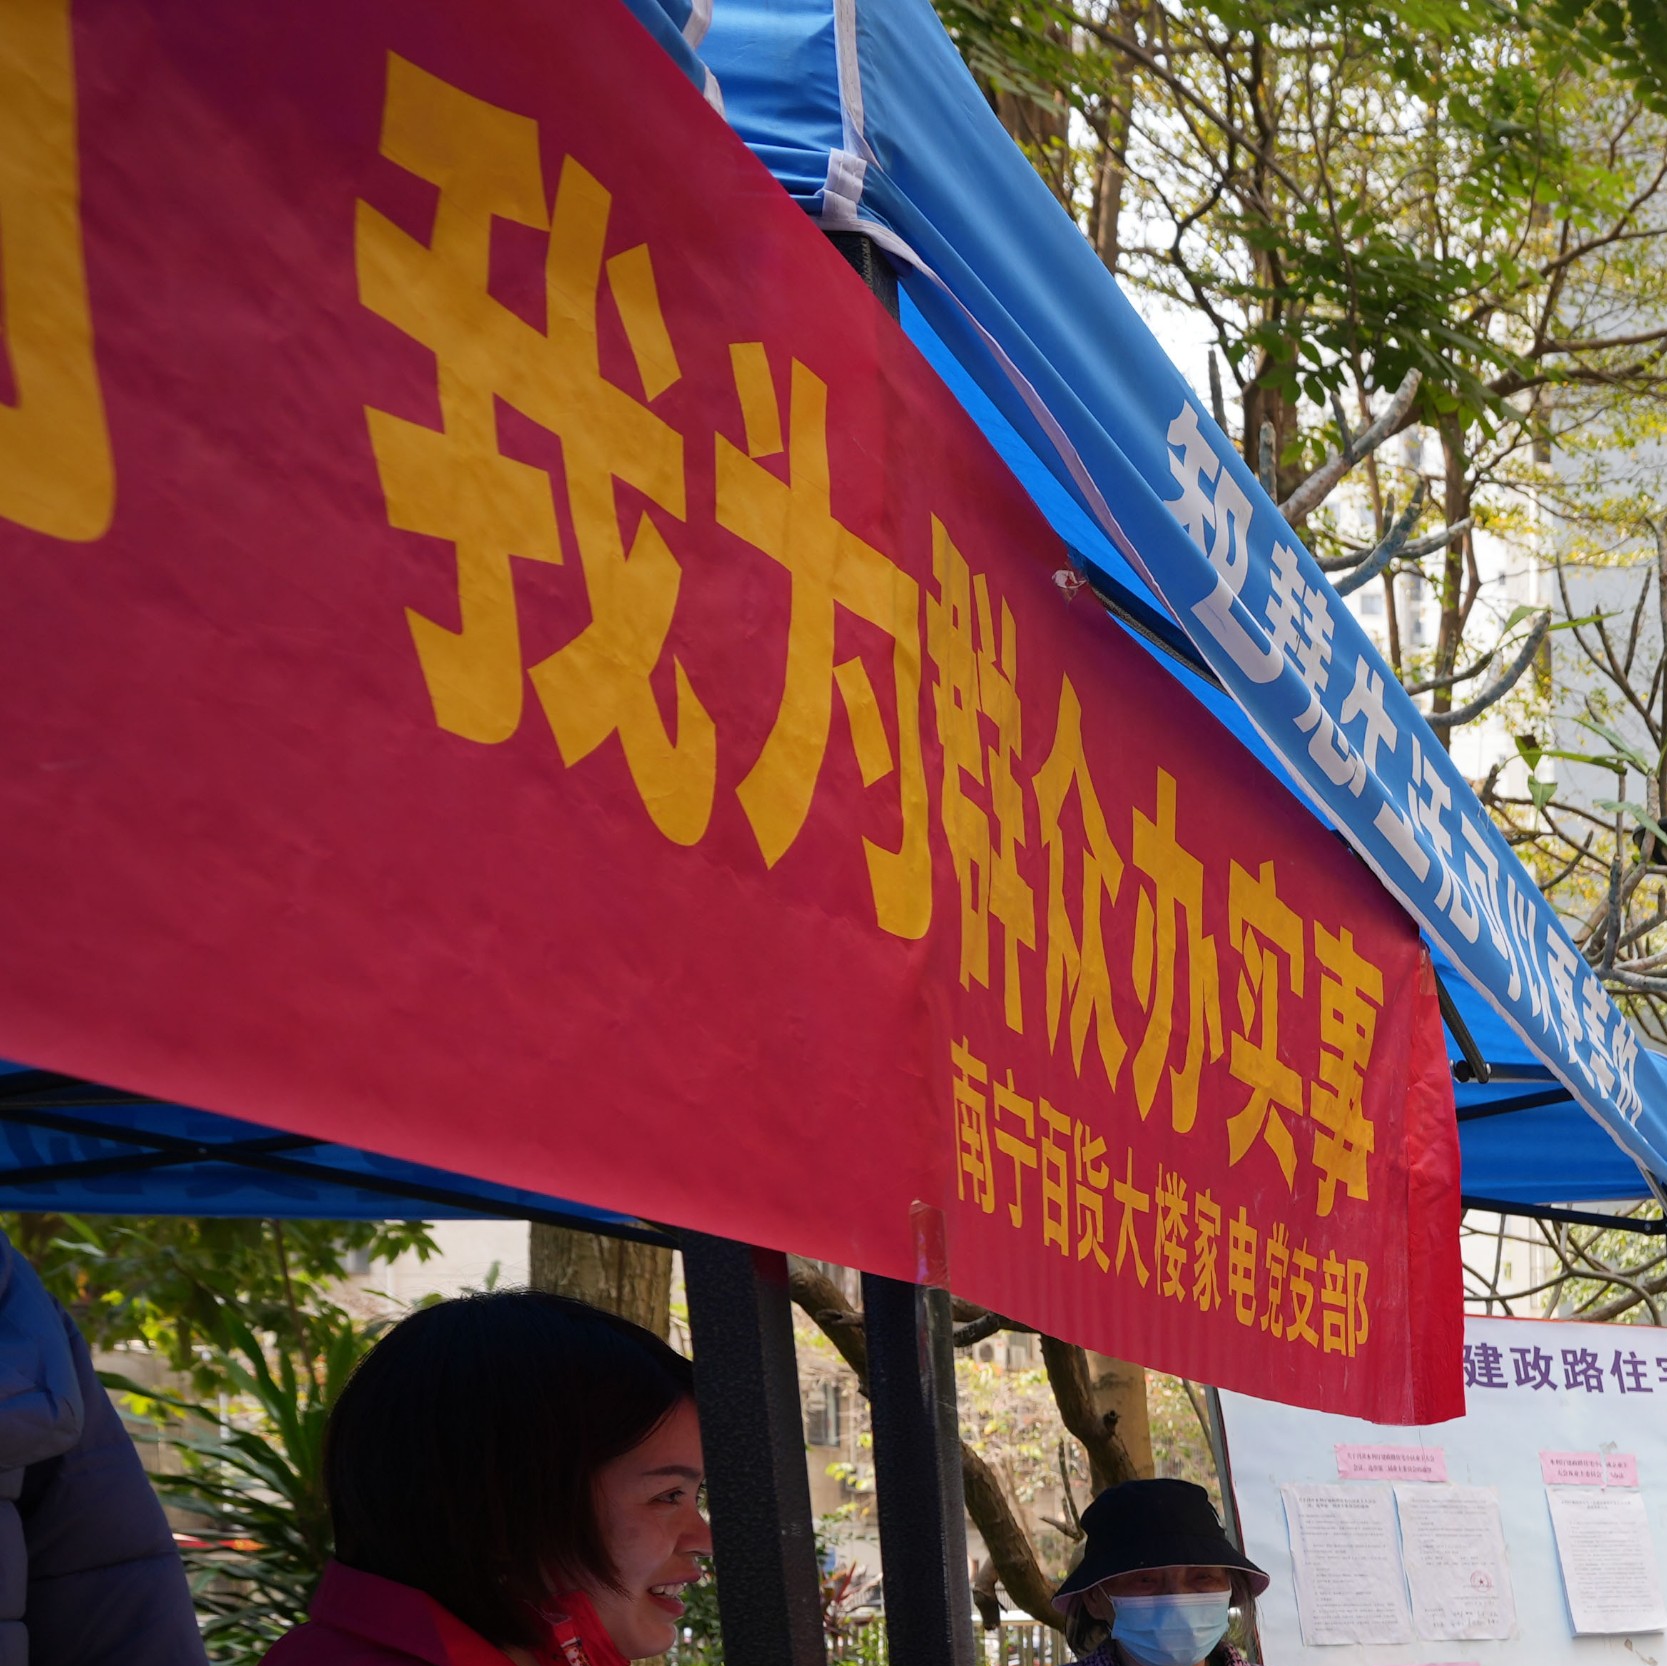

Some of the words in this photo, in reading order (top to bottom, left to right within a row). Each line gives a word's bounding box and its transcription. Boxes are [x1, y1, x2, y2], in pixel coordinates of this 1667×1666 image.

[355, 48, 1384, 1217] 我为群众办实事
[950, 1036, 1369, 1358] 南宁百货大楼家电党支部
